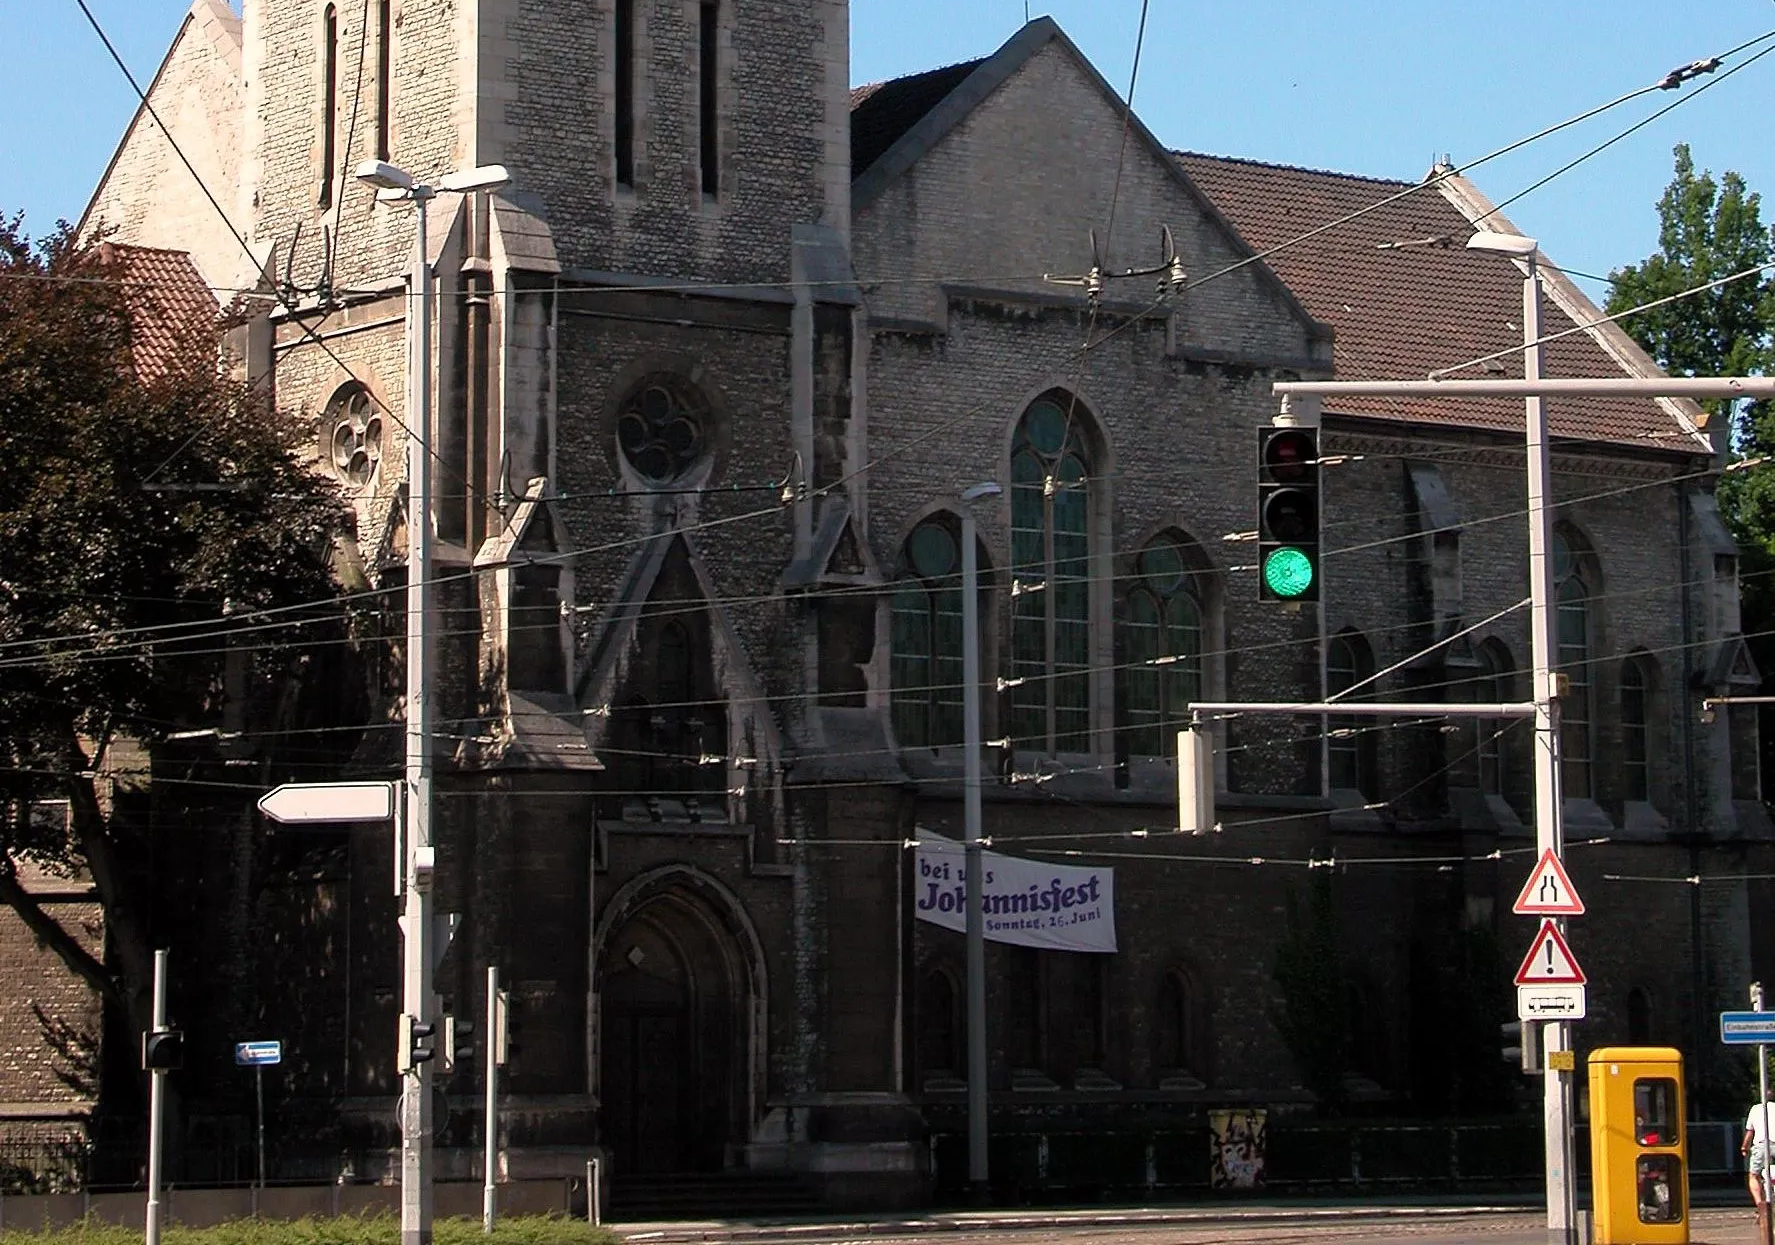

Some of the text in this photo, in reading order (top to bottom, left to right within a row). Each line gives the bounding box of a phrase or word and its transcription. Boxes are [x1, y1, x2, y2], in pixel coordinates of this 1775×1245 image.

[919, 858, 994, 884] bei us
[1071, 907, 1101, 924] Juni
